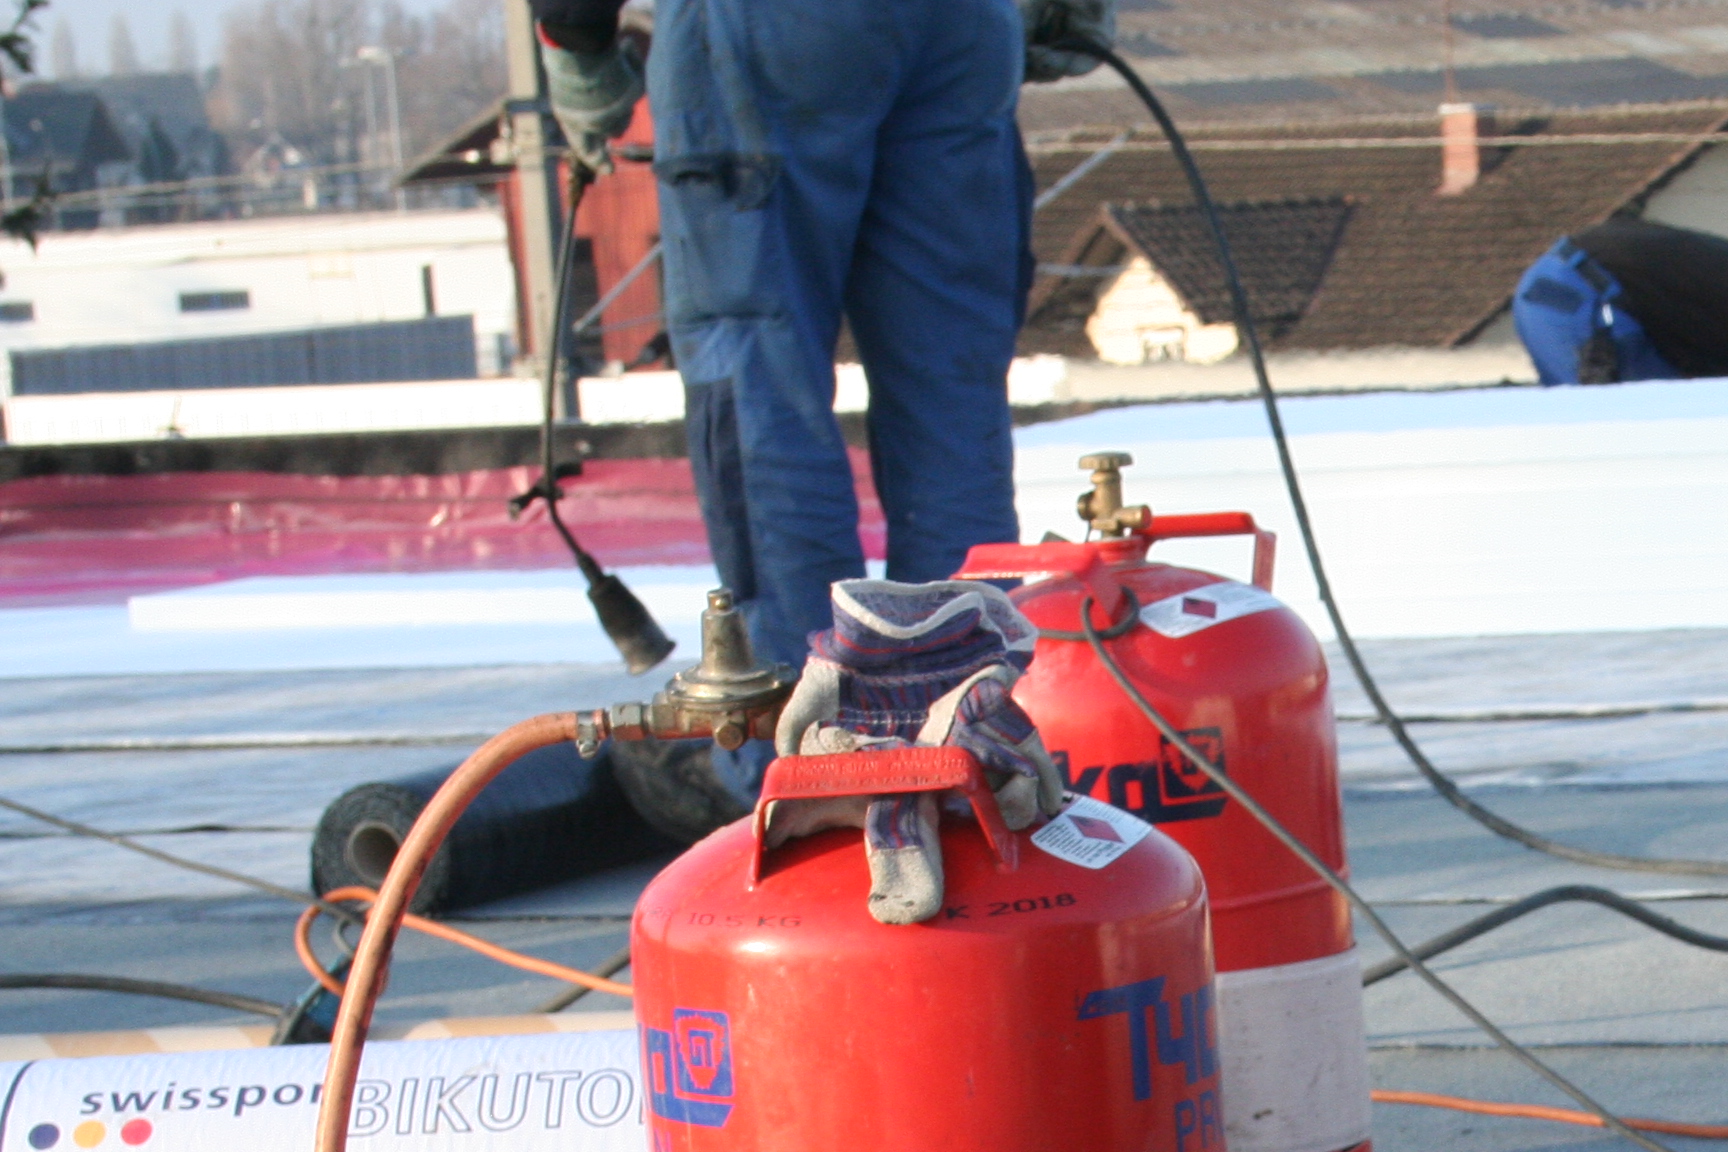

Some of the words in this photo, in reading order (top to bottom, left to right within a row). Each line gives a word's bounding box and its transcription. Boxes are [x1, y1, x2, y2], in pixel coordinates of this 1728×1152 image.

[988, 892, 1076, 917] 2018
[756, 915, 802, 928] KG
[346, 1067, 646, 1138] BIKUTO
